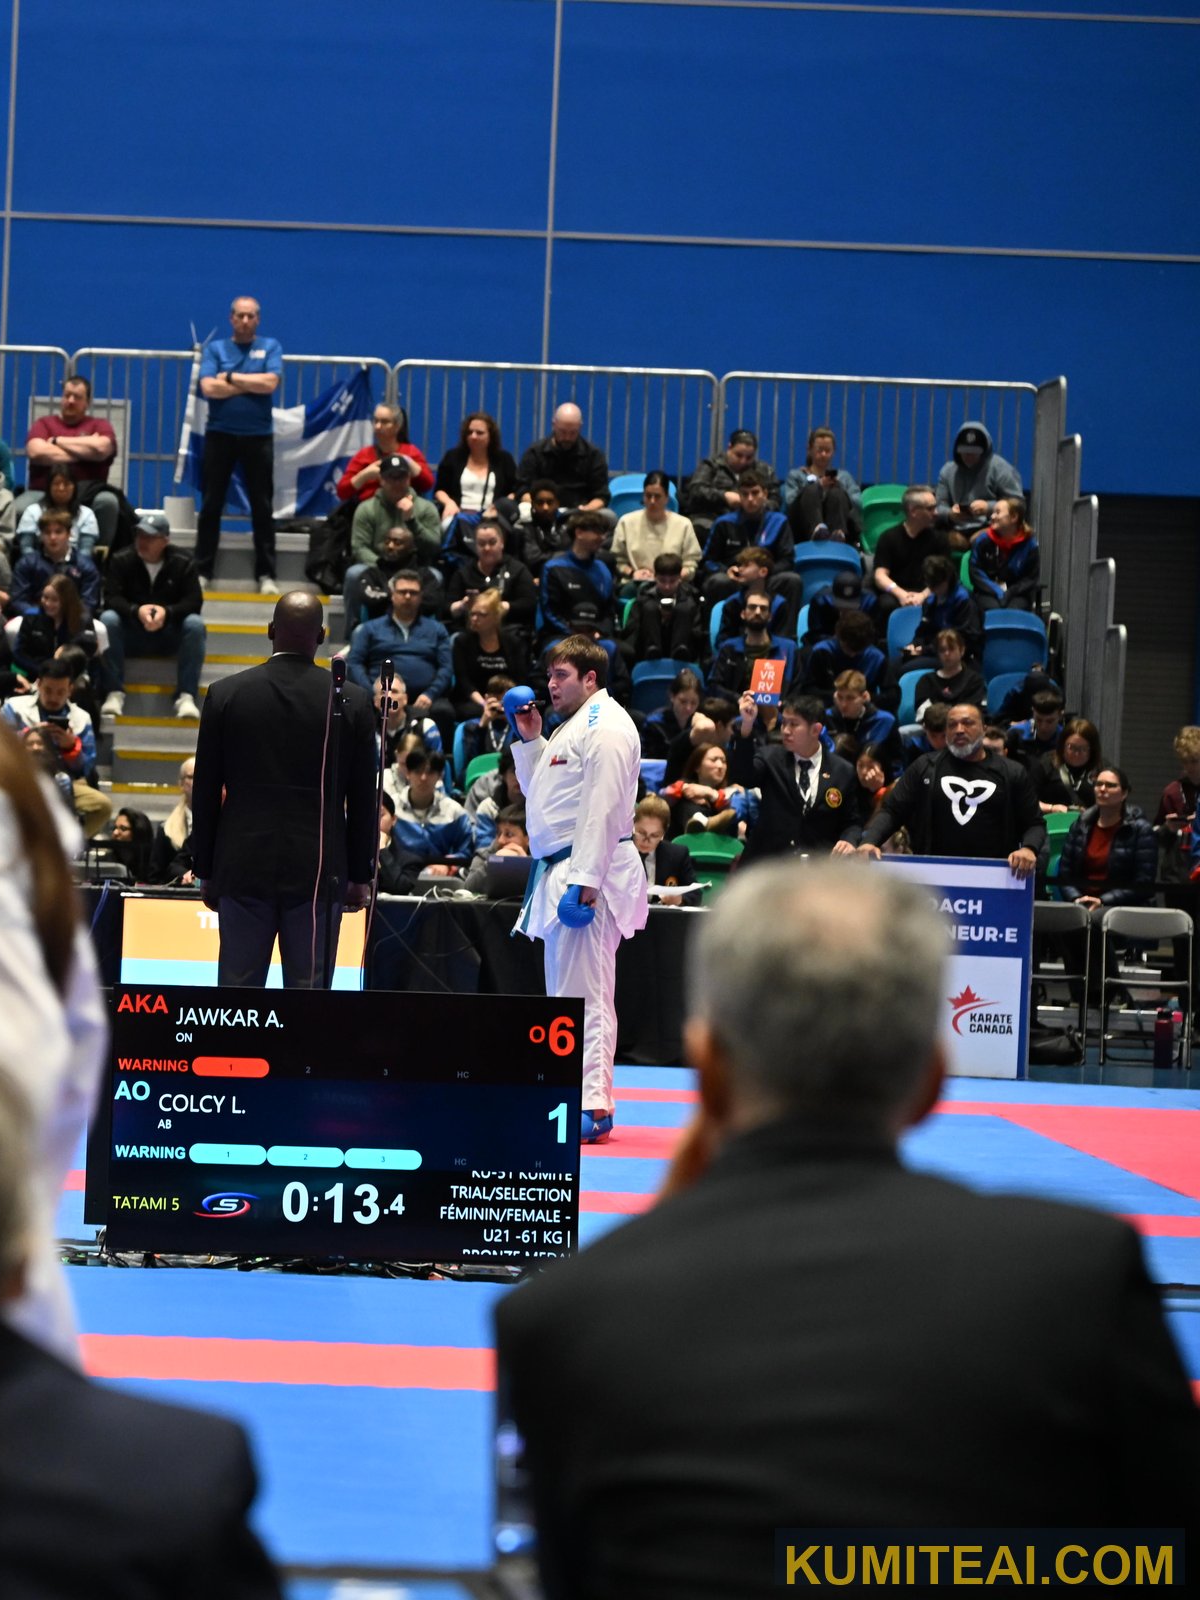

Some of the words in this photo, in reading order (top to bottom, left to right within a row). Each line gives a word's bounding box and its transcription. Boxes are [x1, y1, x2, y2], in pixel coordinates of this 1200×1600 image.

[756, 694, 771, 704] AO
[117, 994, 169, 1014] AKA
[175, 1007, 260, 1028] JAWKAR
[265, 1010, 285, 1028] A.
[969, 1013, 1013, 1024] KARATE
[175, 1032, 193, 1043] ON
[969, 1024, 1013, 1035] CANADA
[118, 1058, 189, 1073] WARNING
[305, 1066, 311, 1074] 2
[457, 1071, 470, 1079] HC
[114, 1080, 151, 1101] AO
[158, 1093, 226, 1114] COLCY
[232, 1096, 246, 1114] L.
[157, 1119, 172, 1130] AB
[548, 1103, 568, 1144] 1
[115, 1144, 186, 1160] WARNING
[454, 1158, 467, 1166] HC
[113, 1195, 167, 1210] TATAMI
[171, 1197, 180, 1211] 5
[450, 1185, 572, 1203] TRIAL/SELECTION
[440, 1203, 561, 1223] FÉMININ/FEMALE
[483, 1228, 509, 1242] U21
[515, 1230, 537, 1243] -61
[543, 1230, 563, 1244] KG
